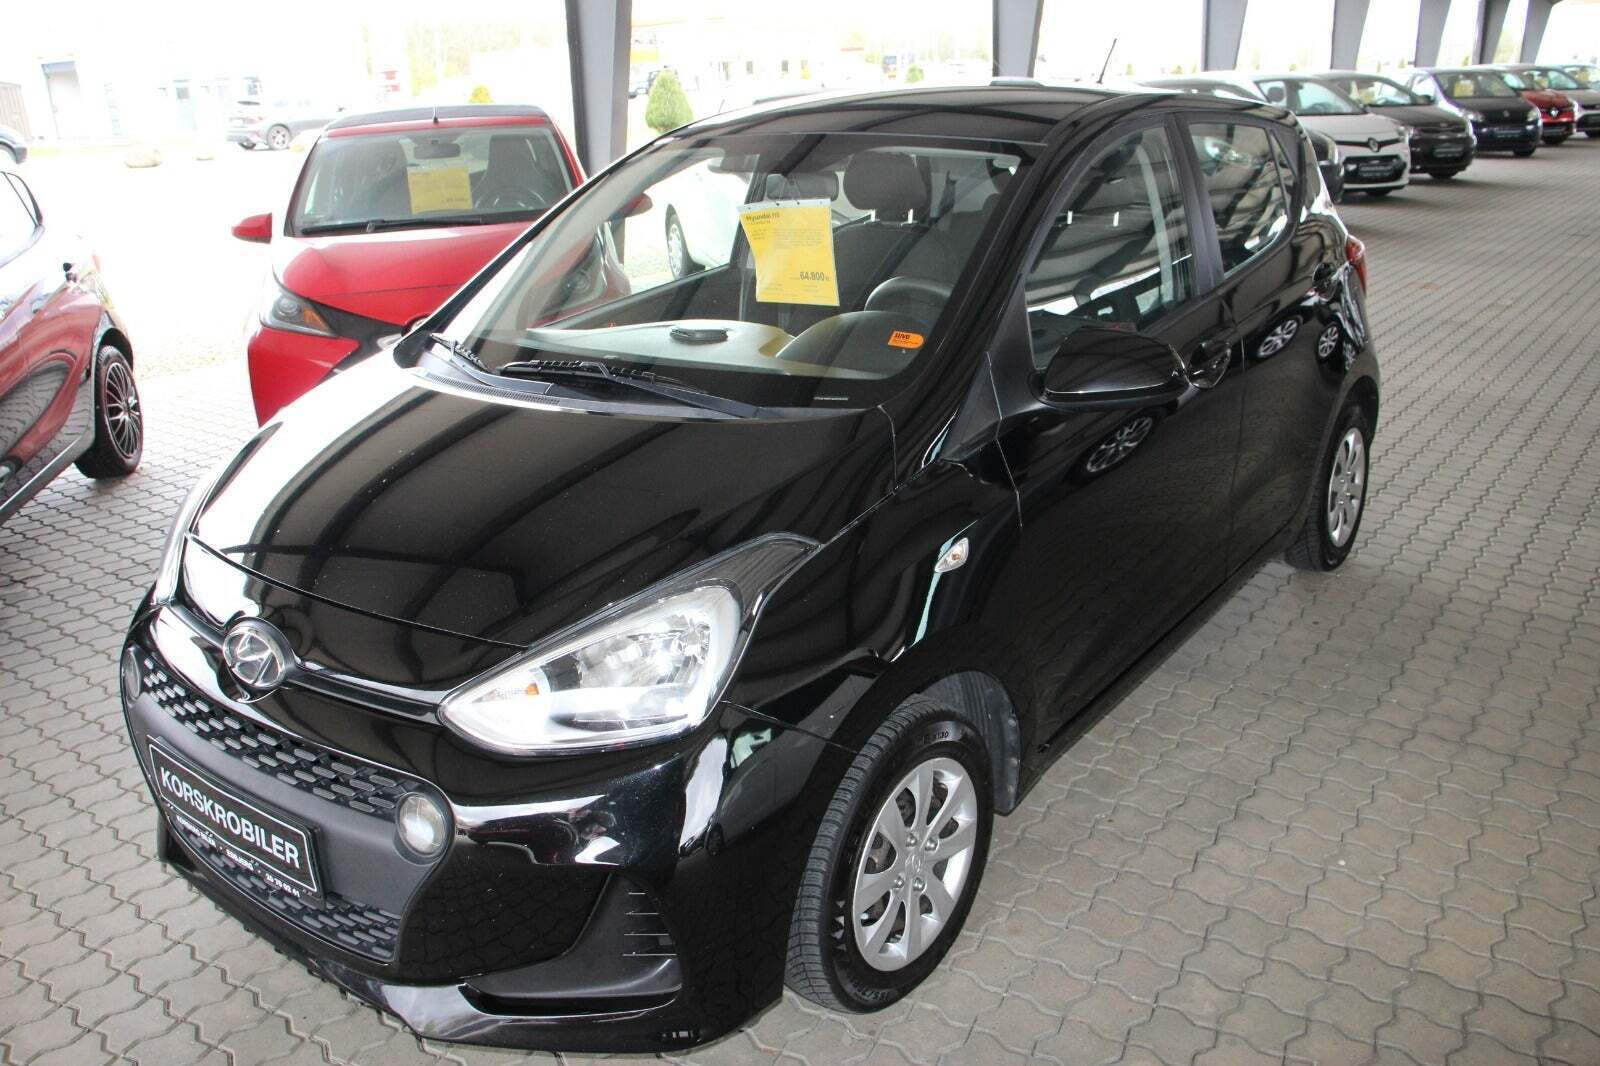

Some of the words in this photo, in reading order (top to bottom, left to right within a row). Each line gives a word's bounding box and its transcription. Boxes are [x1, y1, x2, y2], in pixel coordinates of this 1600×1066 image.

[745, 212, 771, 222] Hyundai
[799, 271, 825, 281] 64.800
[160, 766, 301, 869] KORSKROBILER
